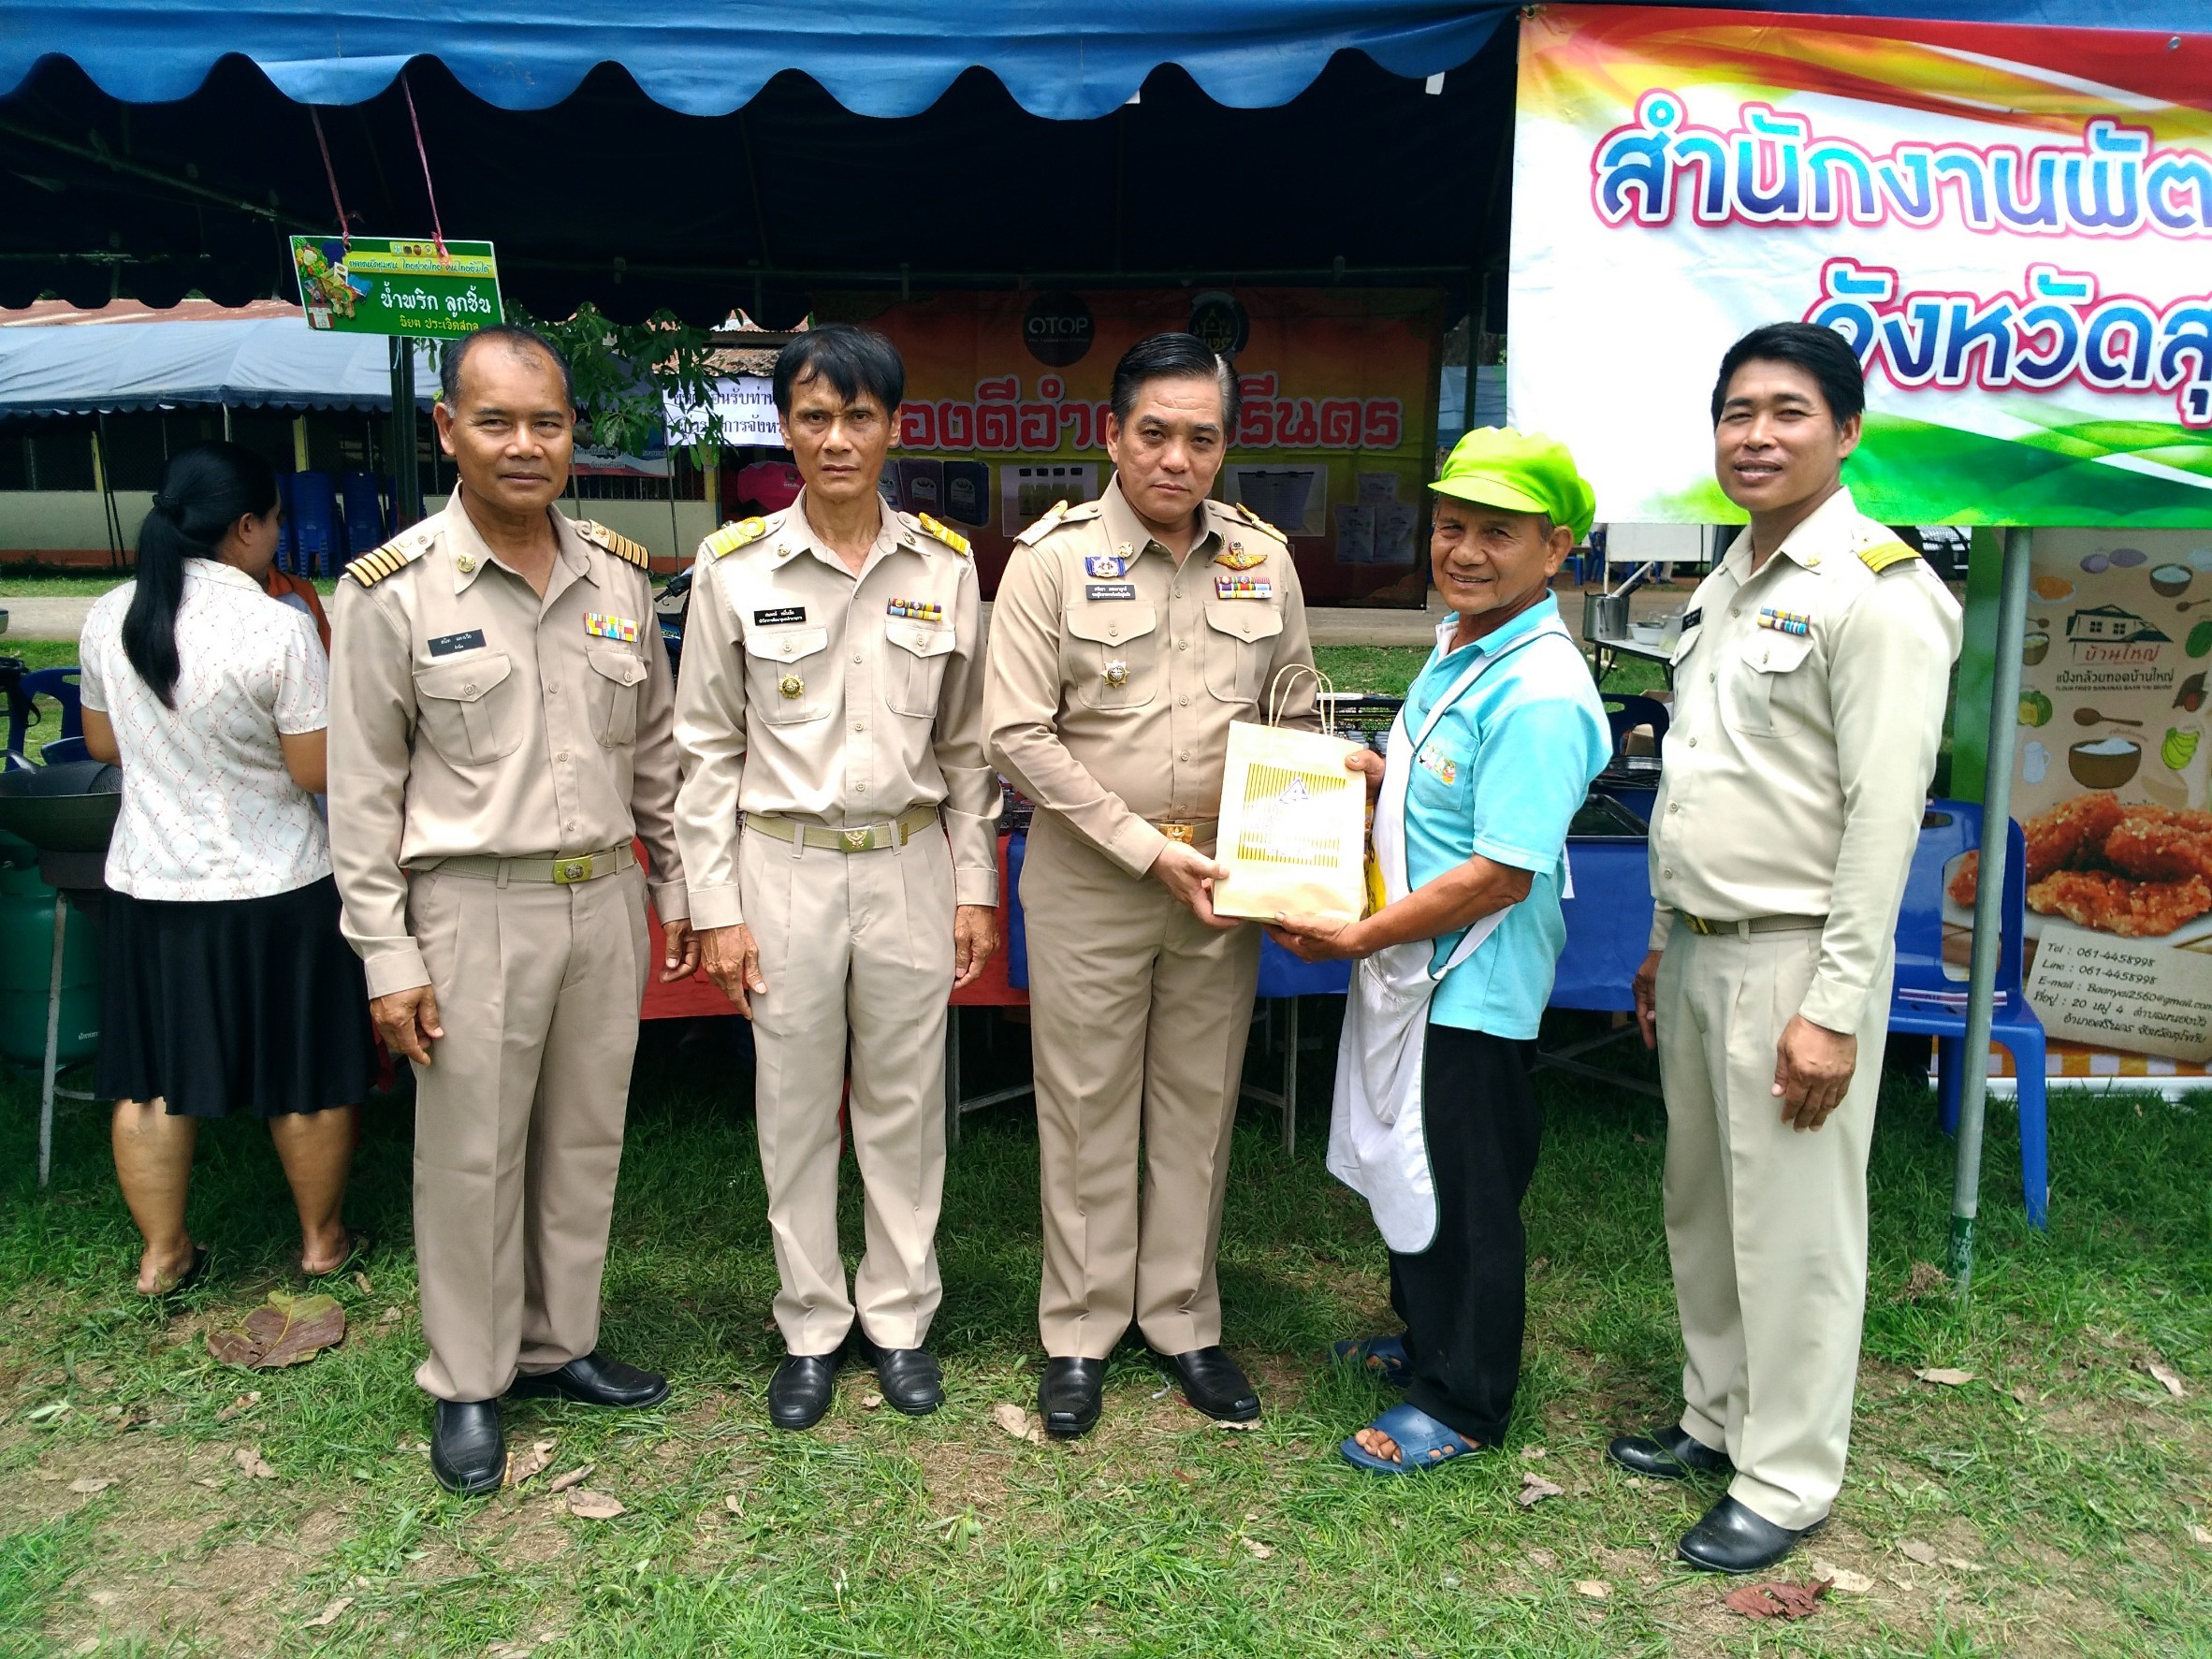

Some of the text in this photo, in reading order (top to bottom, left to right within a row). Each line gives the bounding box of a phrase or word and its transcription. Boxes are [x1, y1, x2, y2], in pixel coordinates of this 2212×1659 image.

[380, 281, 491, 318] น้ำพริก ลูกชิ้น
[1027, 316, 1089, 334] OTOP
[2048, 943, 2064, 953] Tel
[2042, 959, 2065, 970] Line
[2038, 976, 2074, 989] E-mail
[2071, 998, 2087, 1008] 20
